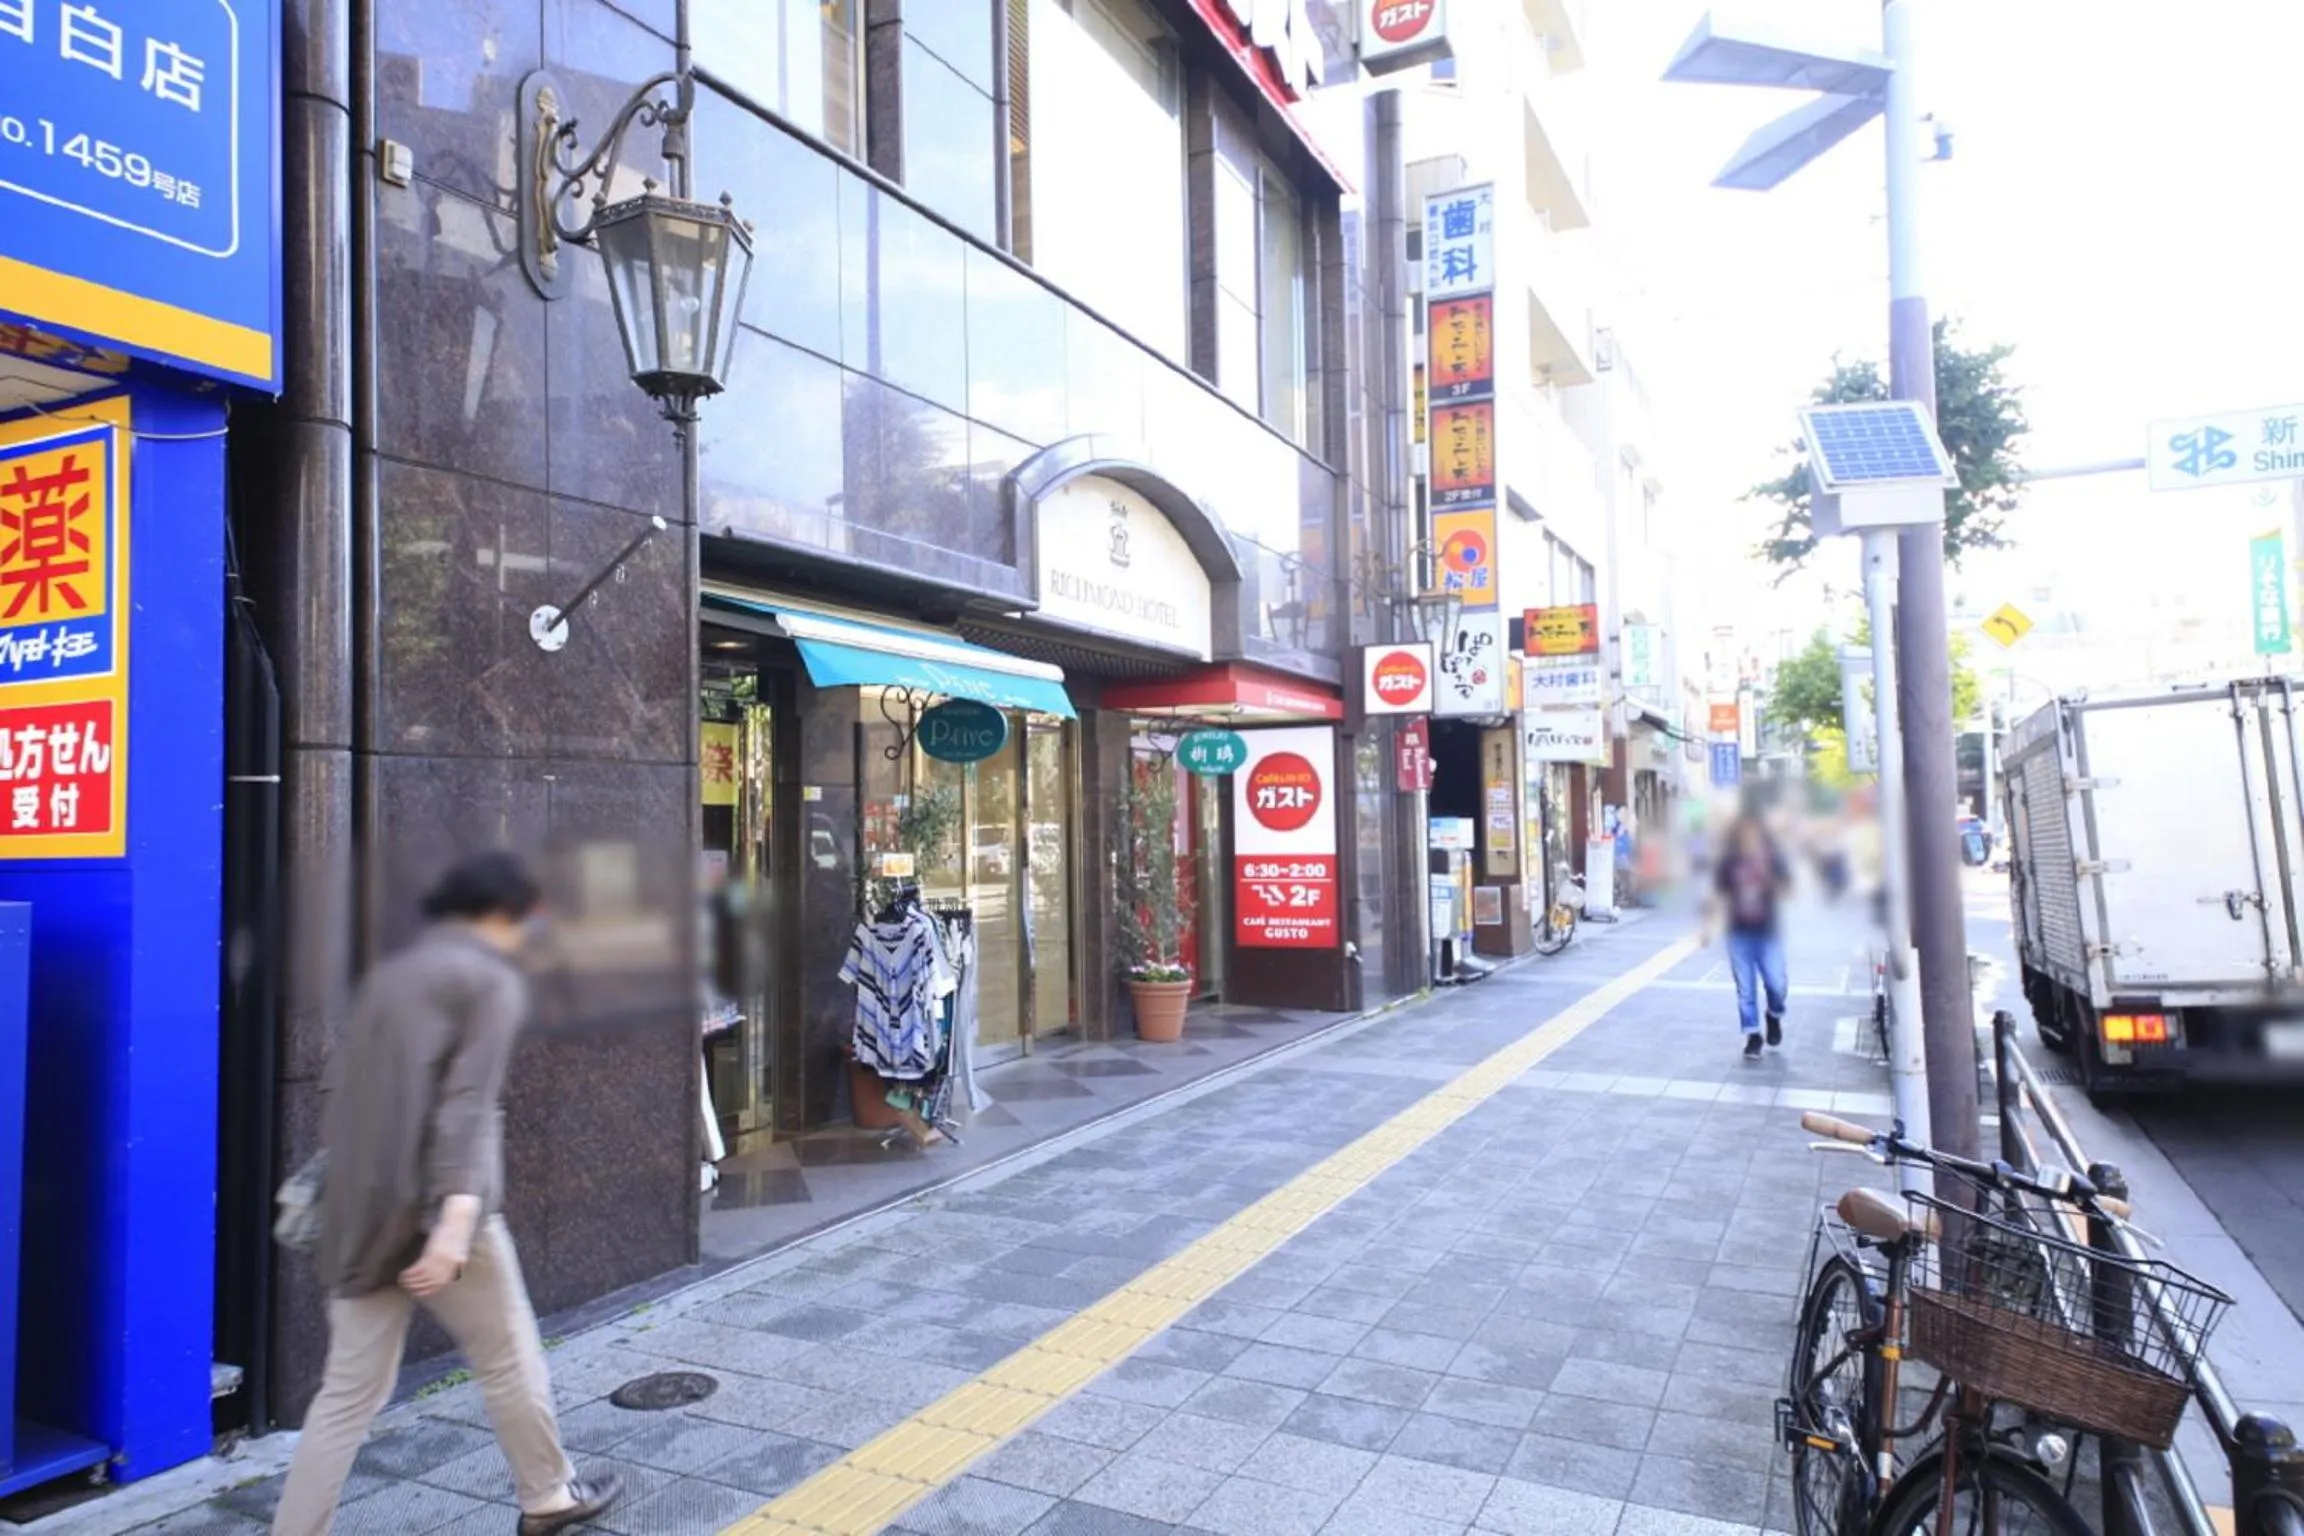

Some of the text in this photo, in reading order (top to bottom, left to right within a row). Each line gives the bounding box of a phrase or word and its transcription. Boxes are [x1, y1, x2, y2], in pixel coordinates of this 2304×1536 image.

[1379, 2, 1430, 29] ガスト
[0, 113, 201, 209] o.1459号店
[1442, 199, 1478, 286] 歯科
[1451, 381, 1472, 396] 3F
[2261, 415, 2299, 446] 新
[1, 455, 90, 619] 薬
[1444, 566, 1488, 590] 松屋
[1050, 568, 1180, 630] RICHMOND HOTEL
[1378, 674, 1421, 691] ガスト
[1532, 671, 1597, 690] 大村歯科
[11, 782, 80, 829] 受付
[1257, 786, 1314, 809] ガスト
[1289, 884, 1321, 907] 2F
[1264, 927, 1308, 939] GUSTO
[1268, 917, 1331, 927] RESTAURANT
